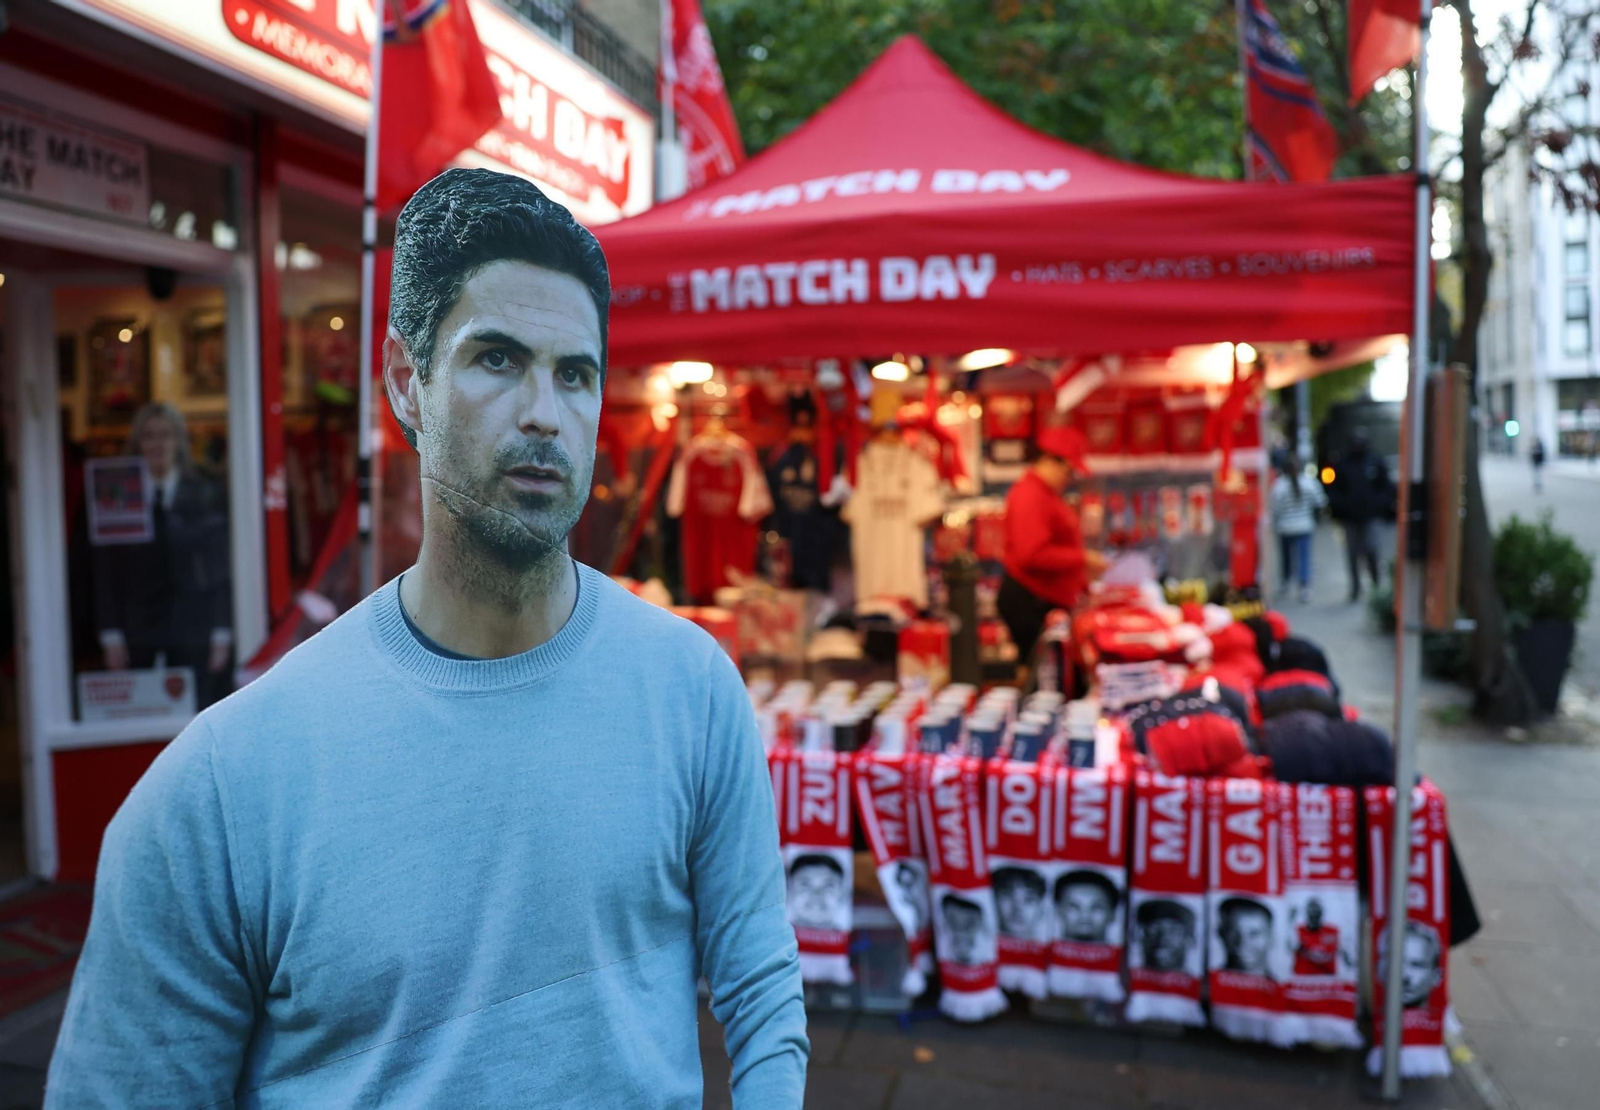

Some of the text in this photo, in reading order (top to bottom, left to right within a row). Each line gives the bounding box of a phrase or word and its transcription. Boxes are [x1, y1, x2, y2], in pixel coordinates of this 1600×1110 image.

[46, 134, 143, 188] MATCH
[709, 168, 921, 218] MATCH
[931, 168, 1070, 194] DAY
[690, 258, 869, 313] MATCH
[879, 253, 996, 302] DAY
[1103, 254, 1213, 282] SCARVES
[1236, 246, 1375, 276] SOUVENIRS
[1001, 762, 1037, 836] DO
